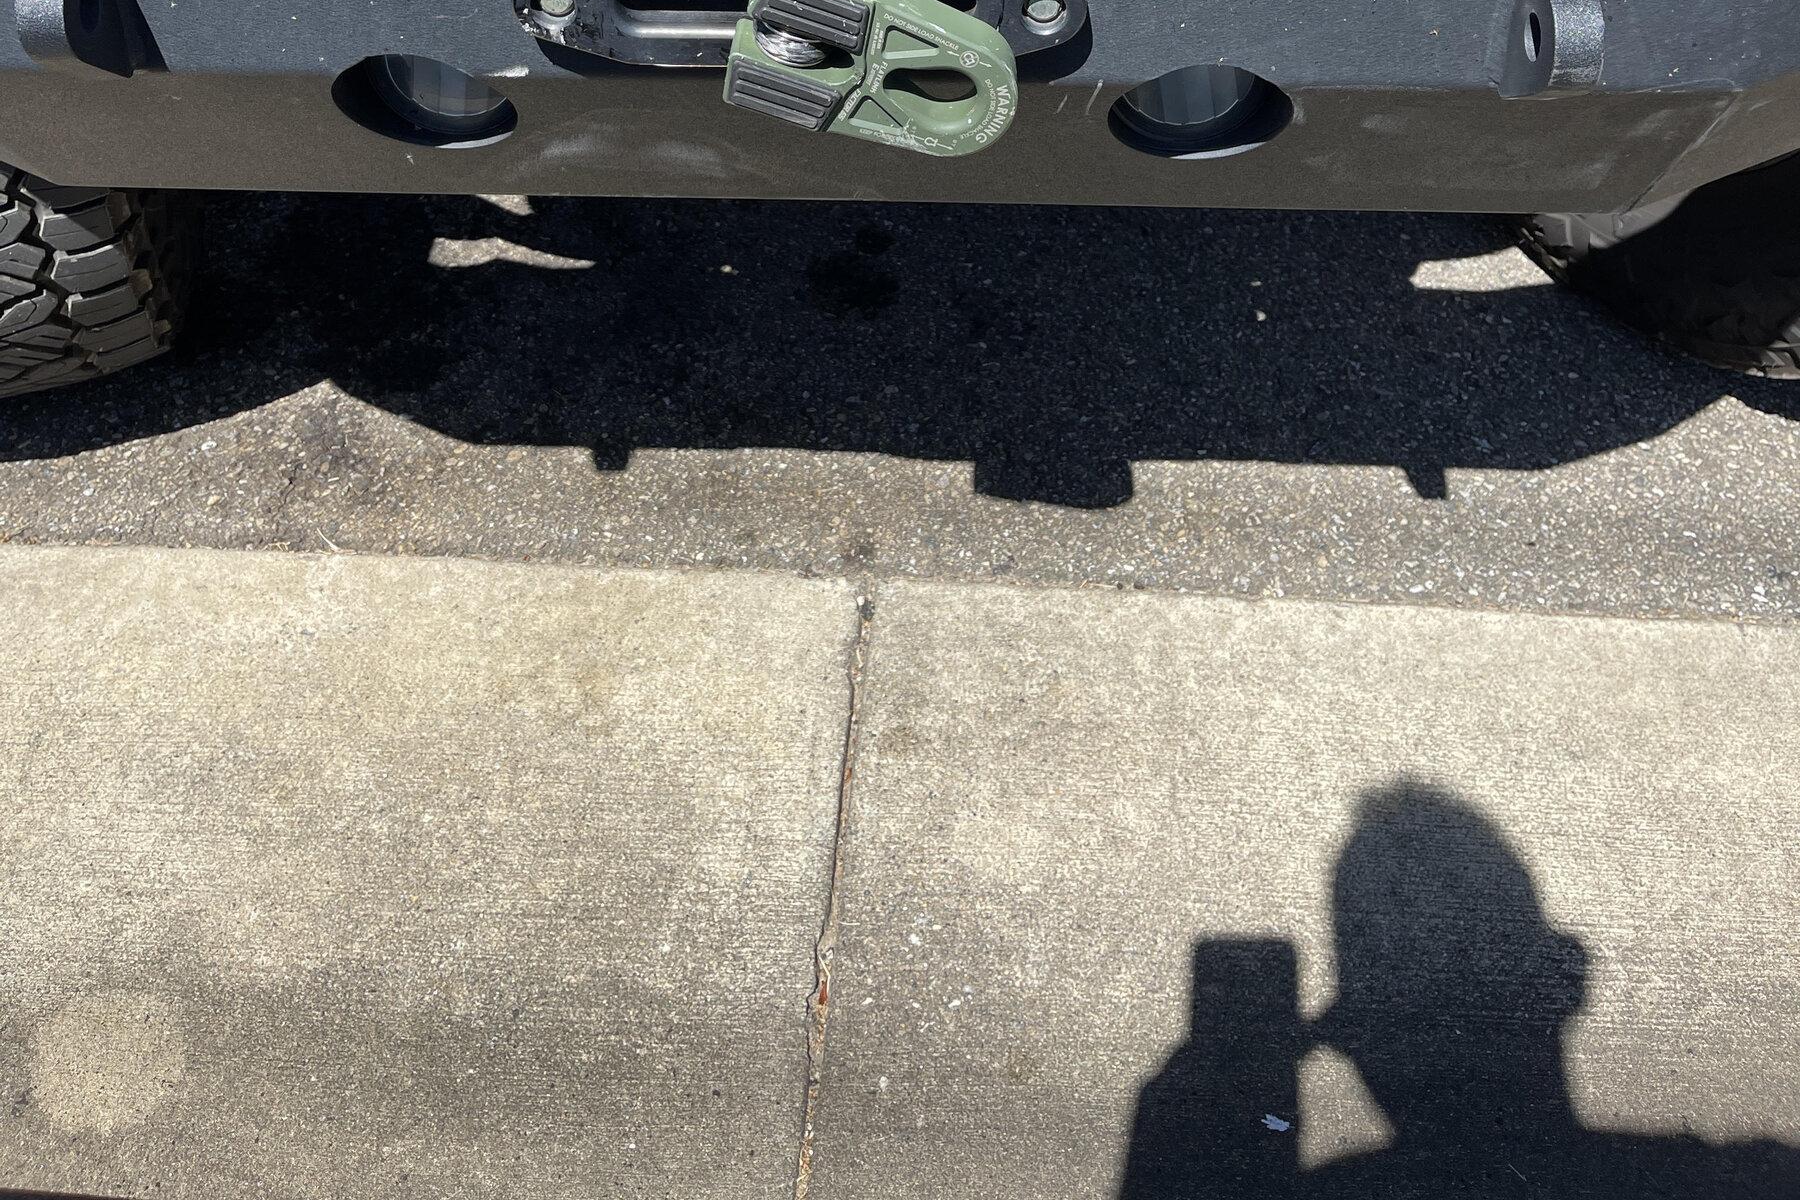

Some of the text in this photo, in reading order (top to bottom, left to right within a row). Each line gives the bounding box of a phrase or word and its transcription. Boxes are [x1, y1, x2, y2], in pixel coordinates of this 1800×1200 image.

[883, 12, 960, 51] DO NOT SIDE LOAD SHACKLE
[870, 61, 889, 94] FLATLINK
[984, 78, 994, 88] DO
[989, 88, 997, 100] NOT
[975, 84, 1011, 143] WARNING
[982, 111, 994, 126] LOAD
